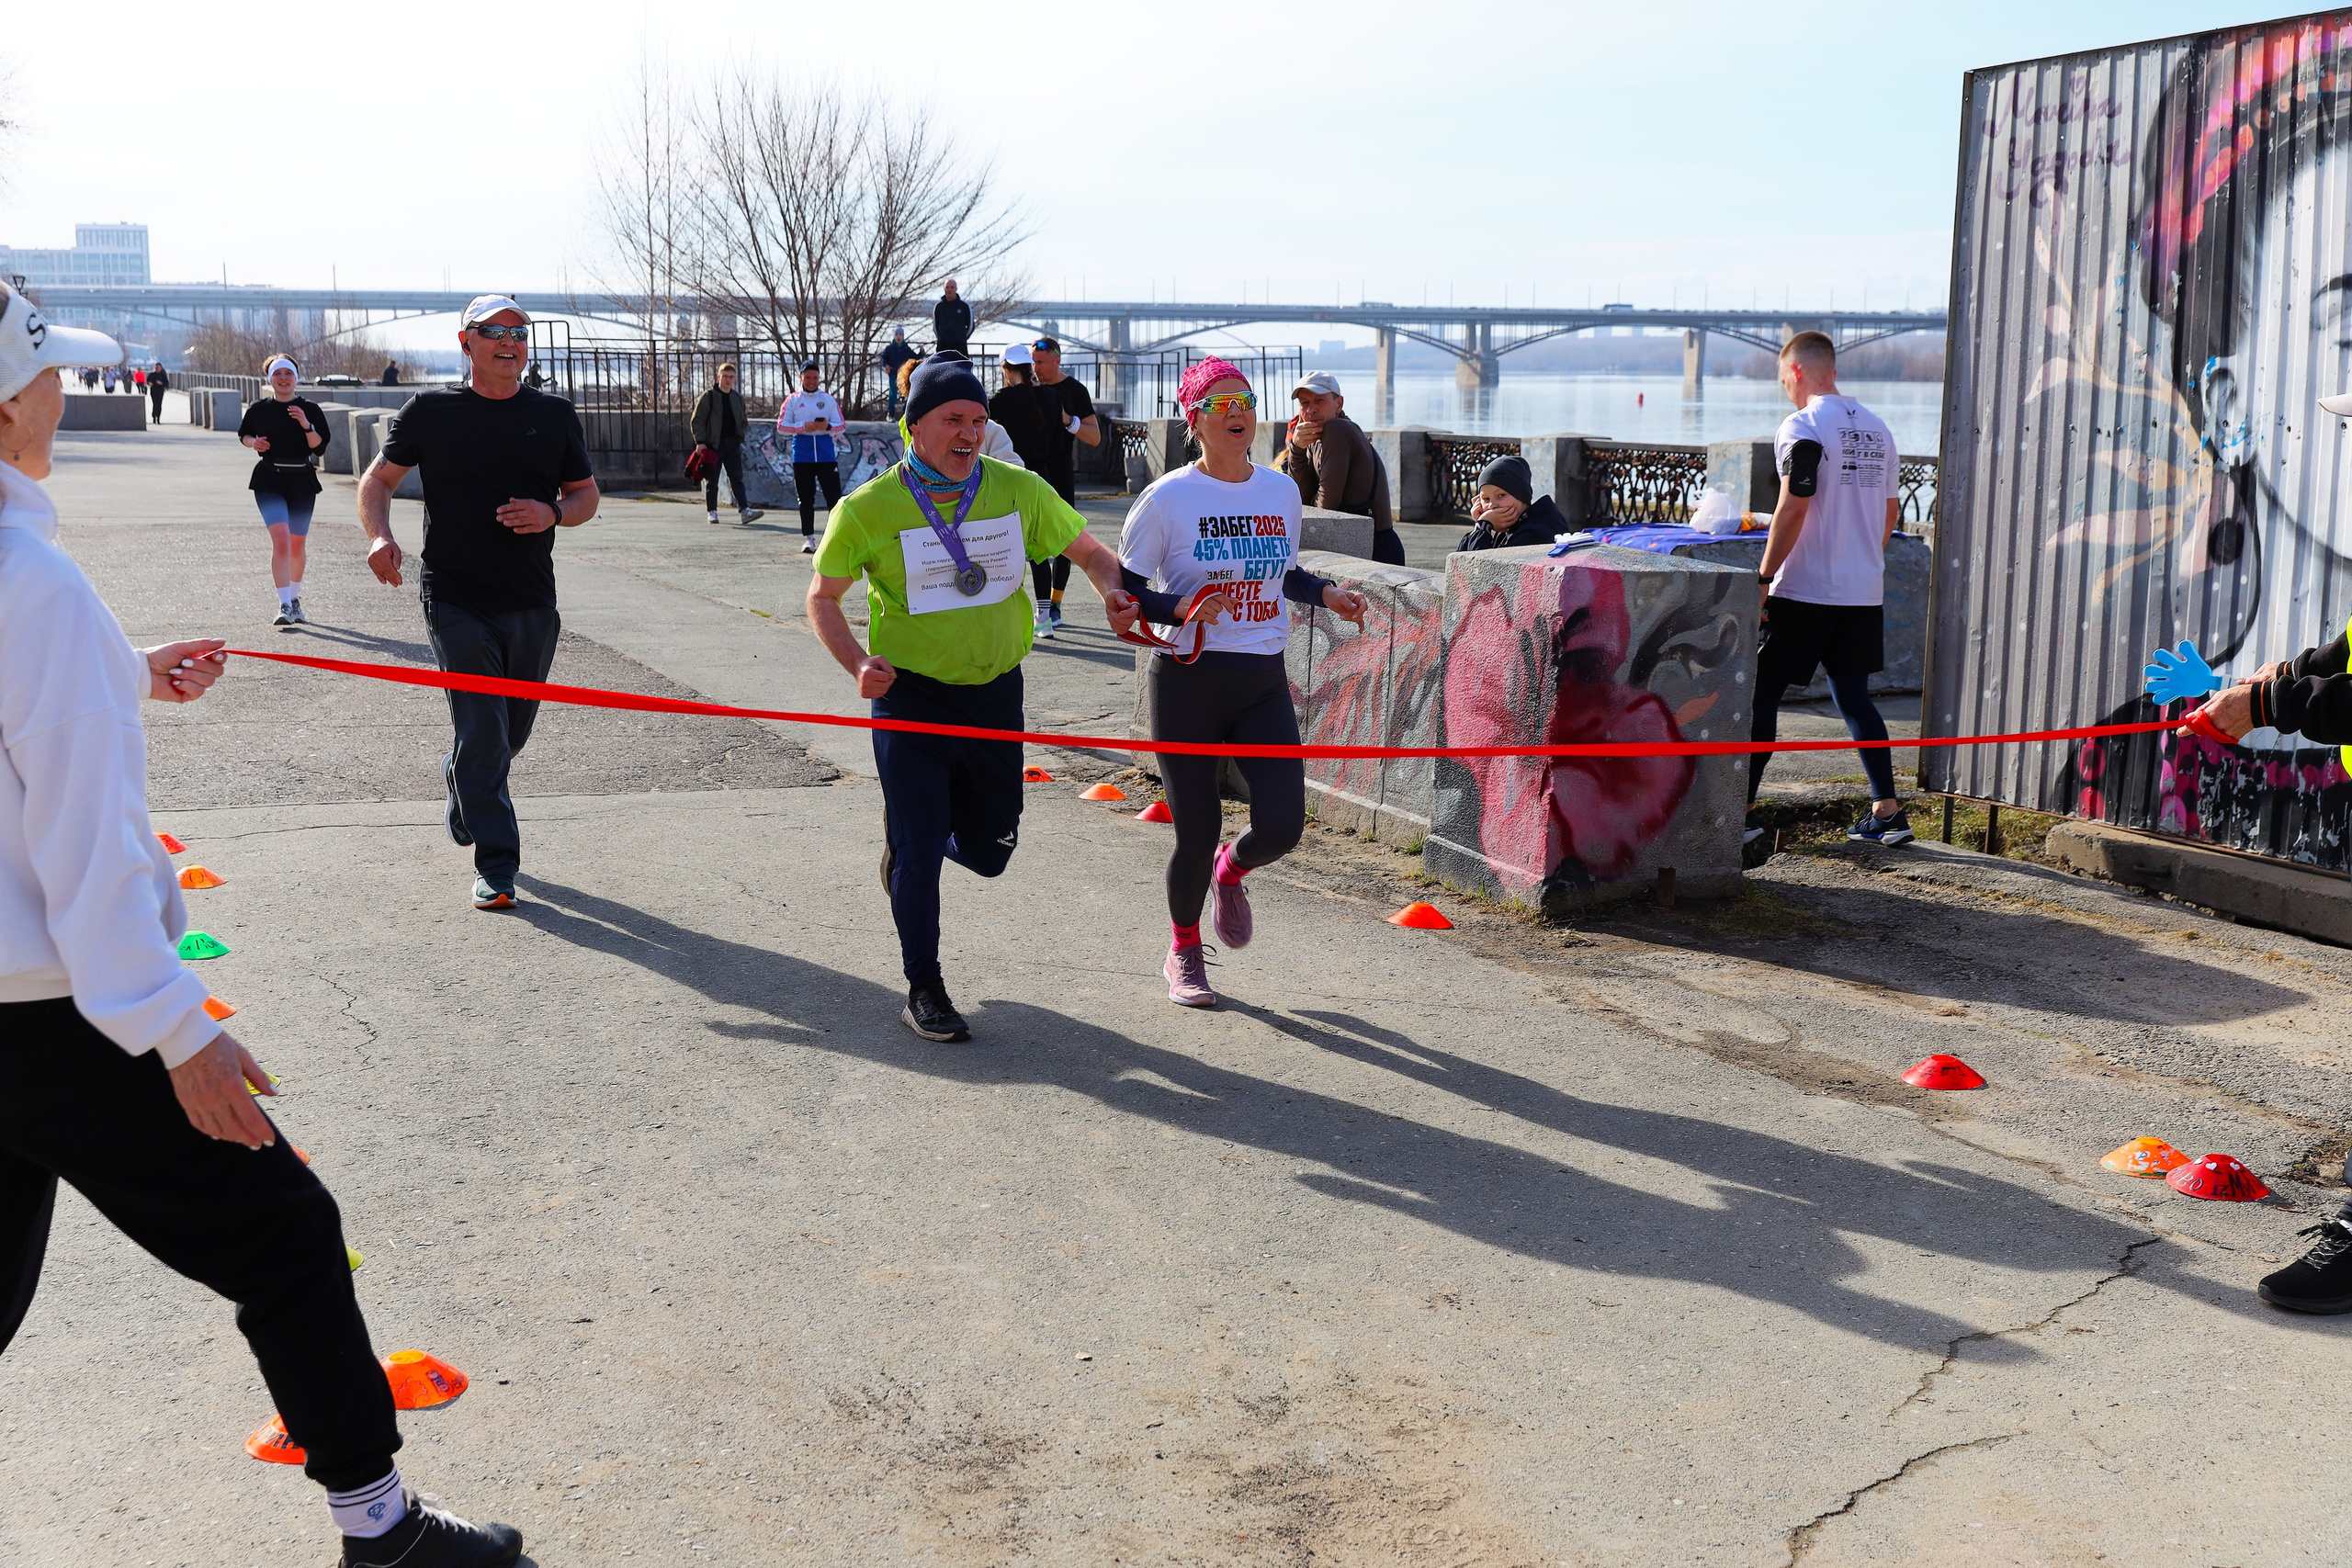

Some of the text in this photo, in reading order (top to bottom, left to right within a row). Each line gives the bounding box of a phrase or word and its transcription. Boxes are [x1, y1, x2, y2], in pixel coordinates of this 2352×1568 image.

[985, 529, 1009, 541] другого!
[1199, 515, 1286, 538] #ЗАБЕГ2025
[1193, 538, 1229, 561] 45%
[989, 574, 1015, 582] победа!
[1243, 558, 1286, 580] БЕГУТ
